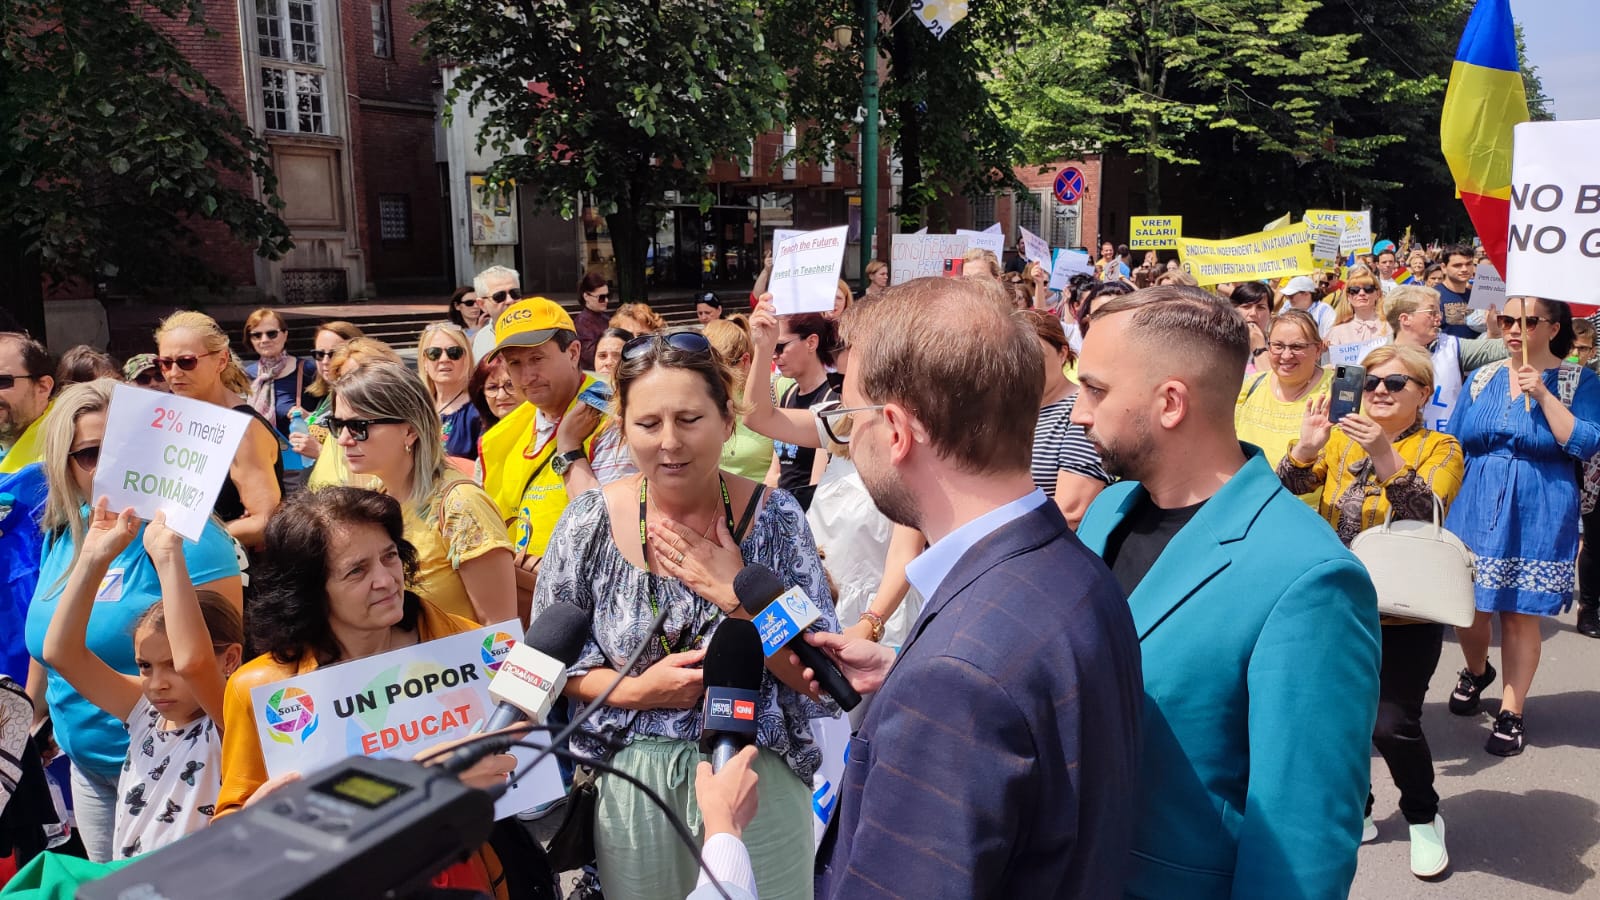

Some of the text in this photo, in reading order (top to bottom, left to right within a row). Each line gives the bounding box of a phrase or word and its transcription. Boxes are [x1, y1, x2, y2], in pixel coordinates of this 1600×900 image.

[1511, 183, 1563, 212] NO
[1142, 219, 1171, 227] VREM
[1508, 224, 1567, 254] NO
[780, 243, 798, 255] Teach
[799, 241, 811, 250] the
[1186, 245, 1216, 256] SINDICATUL
[1217, 243, 1252, 256] INDEPENDENT
[1254, 243, 1261, 254] AL
[792, 268, 800, 276] in
[1200, 263, 1245, 276] PREUNIVERSITAR
[1246, 263, 1256, 273] DIN
[1339, 345, 1359, 353] SUNT
[151, 407, 227, 445] 2% merită
[163, 444, 209, 475] COPIII
[760, 618, 788, 642] EUROPA
[769, 628, 789, 647] NOVA
[333, 662, 480, 719] UN POPOR
[541, 681, 552, 690] TV
[736, 705, 752, 715] CNN
[361, 704, 471, 755] EDUCAT
